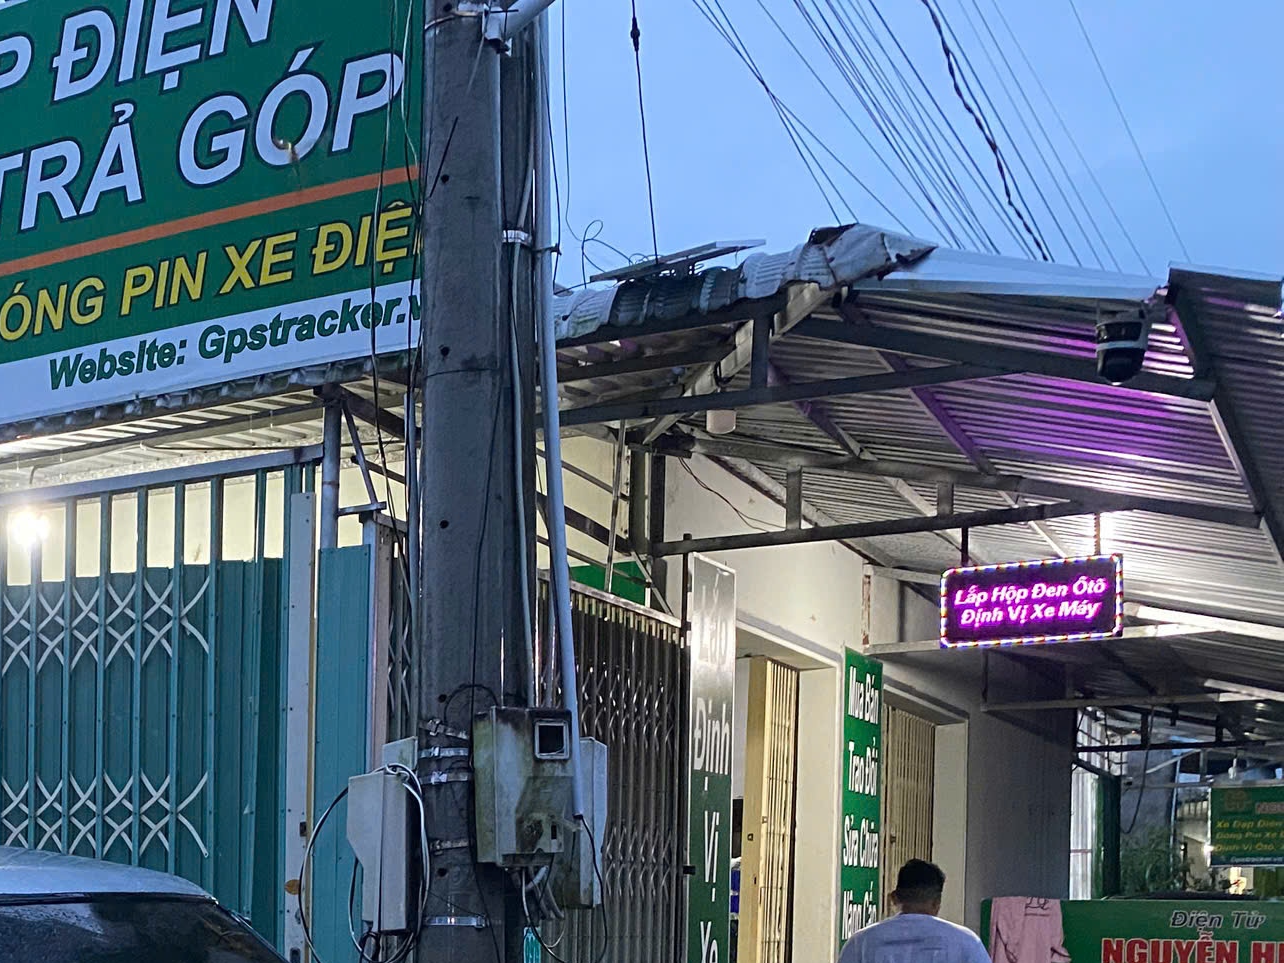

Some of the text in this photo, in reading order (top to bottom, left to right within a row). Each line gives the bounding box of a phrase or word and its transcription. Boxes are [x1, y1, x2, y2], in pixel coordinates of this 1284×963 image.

[178, 47, 405, 186] GÓP
[120, 251, 207, 316] PIN
[218, 231, 298, 295] XE
[312, 200, 422, 275] ĐIỆ
[954, 575, 1108, 607] Lắp Hộp Đen Ôtô
[961, 600, 1103, 628] Định Vị Xe Máy
[848, 665, 879, 725] Mua Bán
[694, 696, 730, 792] Định
[848, 741, 864, 794] Trao
[704, 810, 720, 902] Vị
[1170, 910, 1266, 932] Điện Tử
